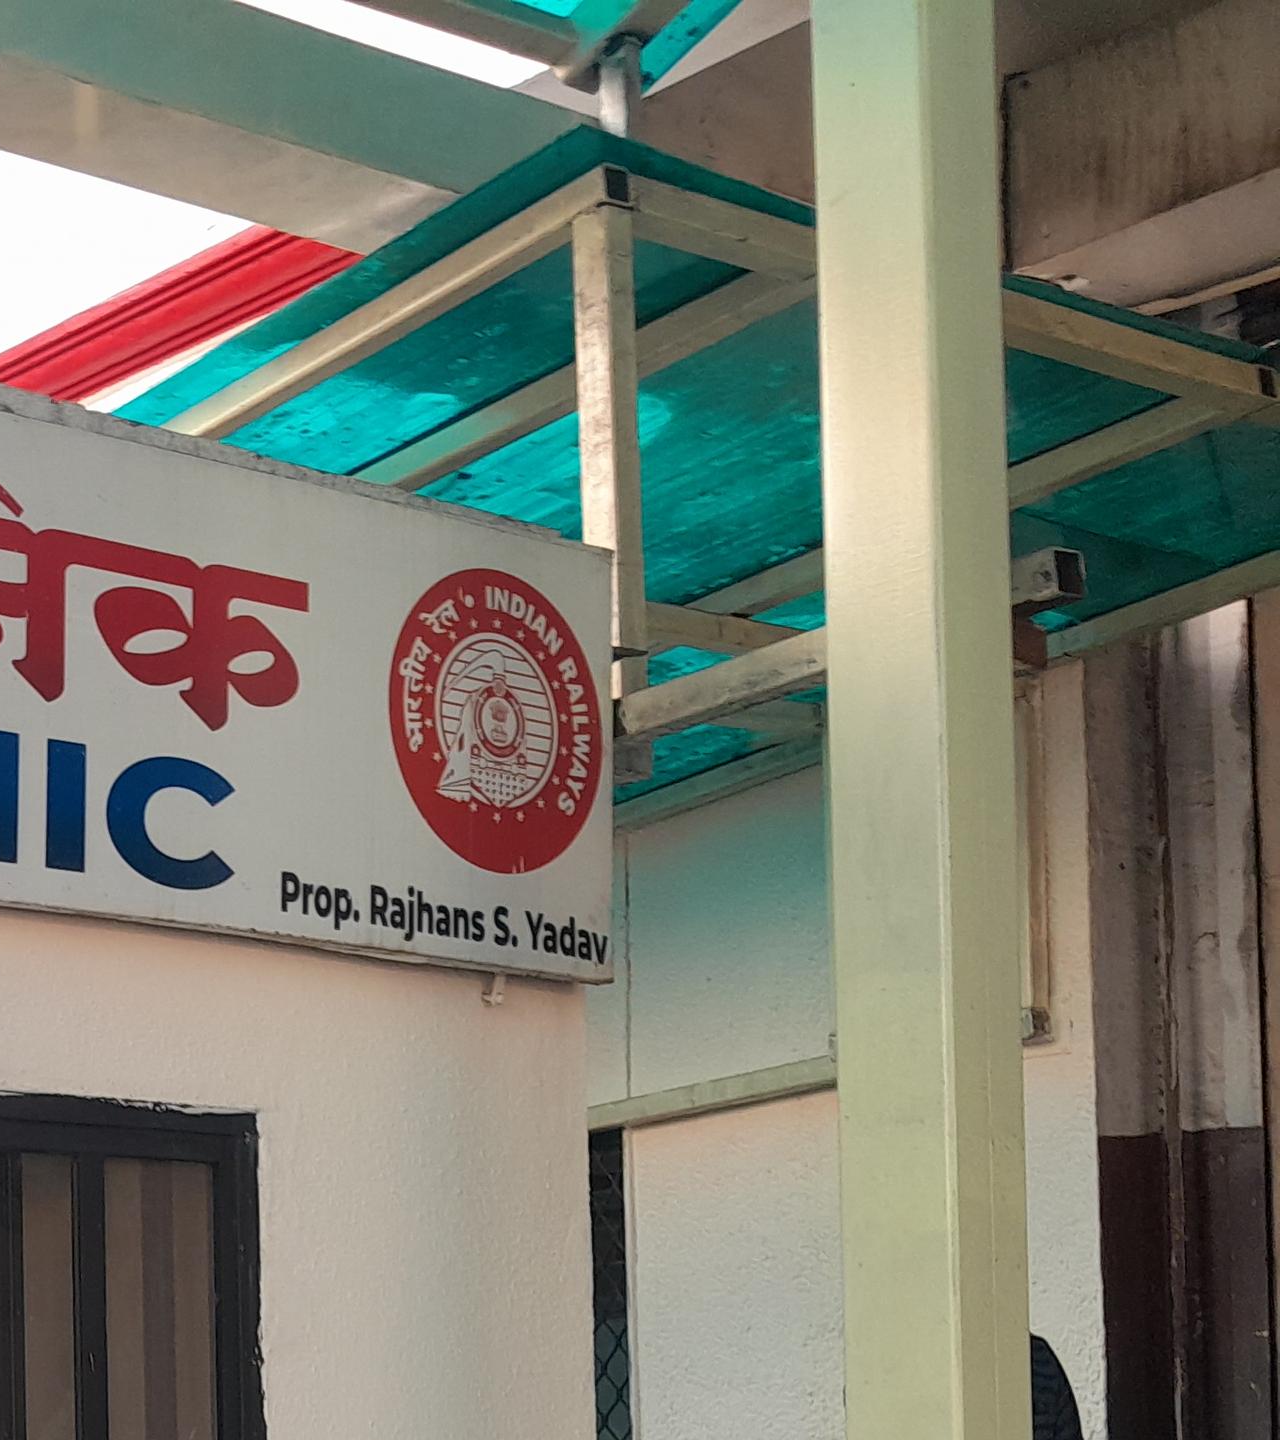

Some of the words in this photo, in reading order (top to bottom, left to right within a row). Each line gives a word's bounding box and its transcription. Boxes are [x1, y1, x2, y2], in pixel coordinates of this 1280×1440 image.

[399, 636, 432, 753] भारतीय
[419, 598, 461, 634] रेल
[483, 585, 565, 656] INDIAN
[557, 655, 593, 817] RAILWAYS
[281, 871, 360, 929] Prop.
[370, 884, 485, 942] Rajhans
[493, 905, 518, 947] S.
[524, 910, 608, 966] Yadav
